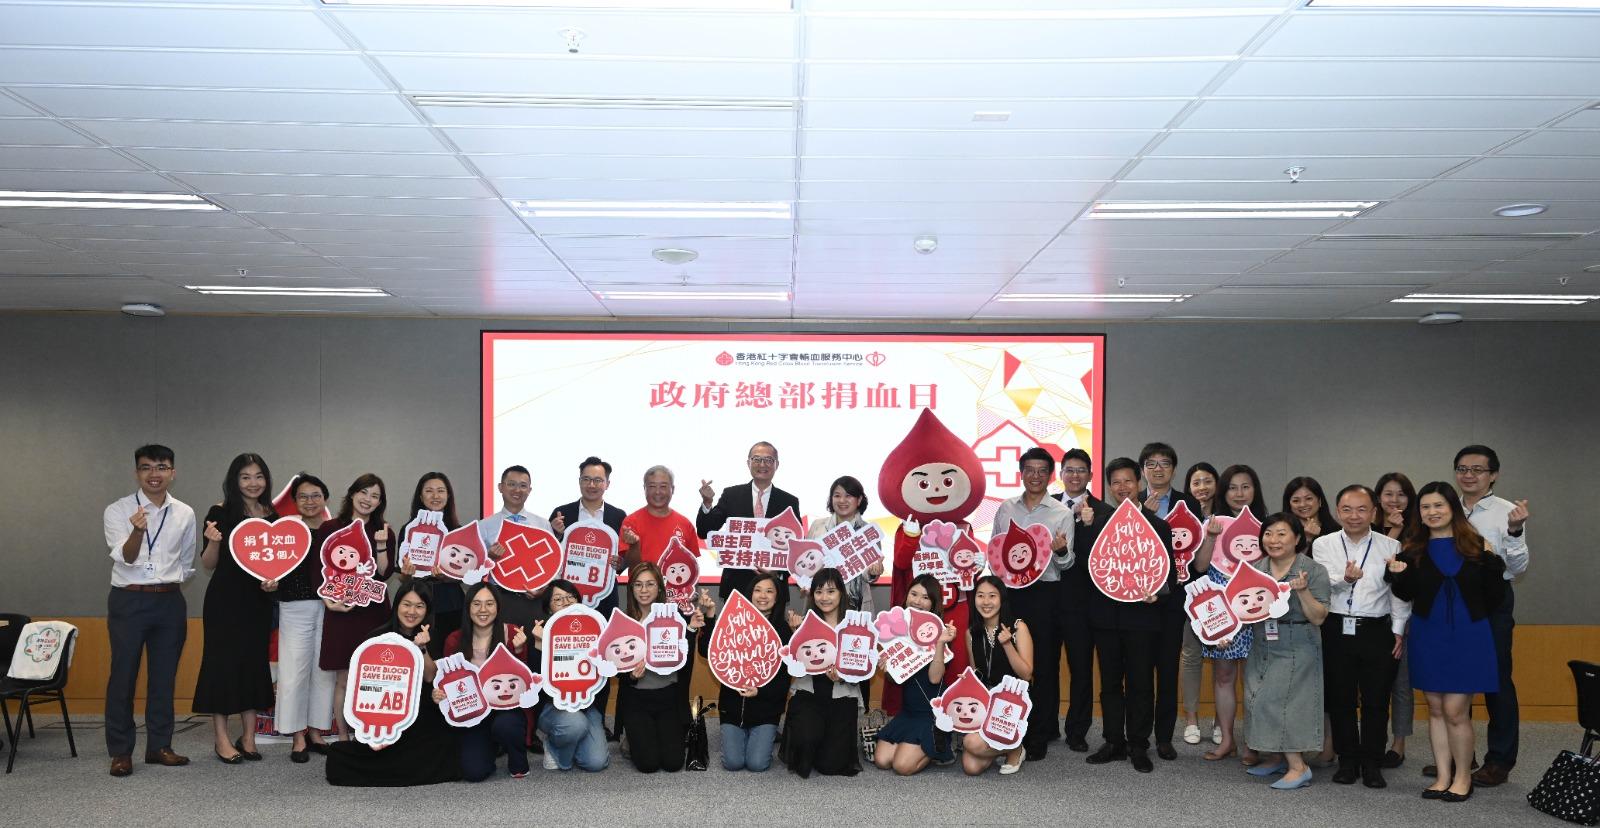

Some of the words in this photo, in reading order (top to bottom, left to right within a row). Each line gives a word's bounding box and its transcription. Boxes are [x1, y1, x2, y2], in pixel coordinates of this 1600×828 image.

[650, 380, 938, 410] 政府總部捐血日
[729, 519, 757, 533] 醫務
[711, 535, 752, 548] 衛生局
[822, 525, 852, 550] 醫務
[839, 526, 880, 559] 衛生局
[719, 550, 787, 567] 支持捐血
[1095, 555, 1165, 578] giving
[588, 566, 600, 583] B
[716, 640, 778, 671] giving
[363, 665, 381, 673] GIVE
[382, 667, 409, 675] BLOOD
[379, 691, 403, 711] AB
